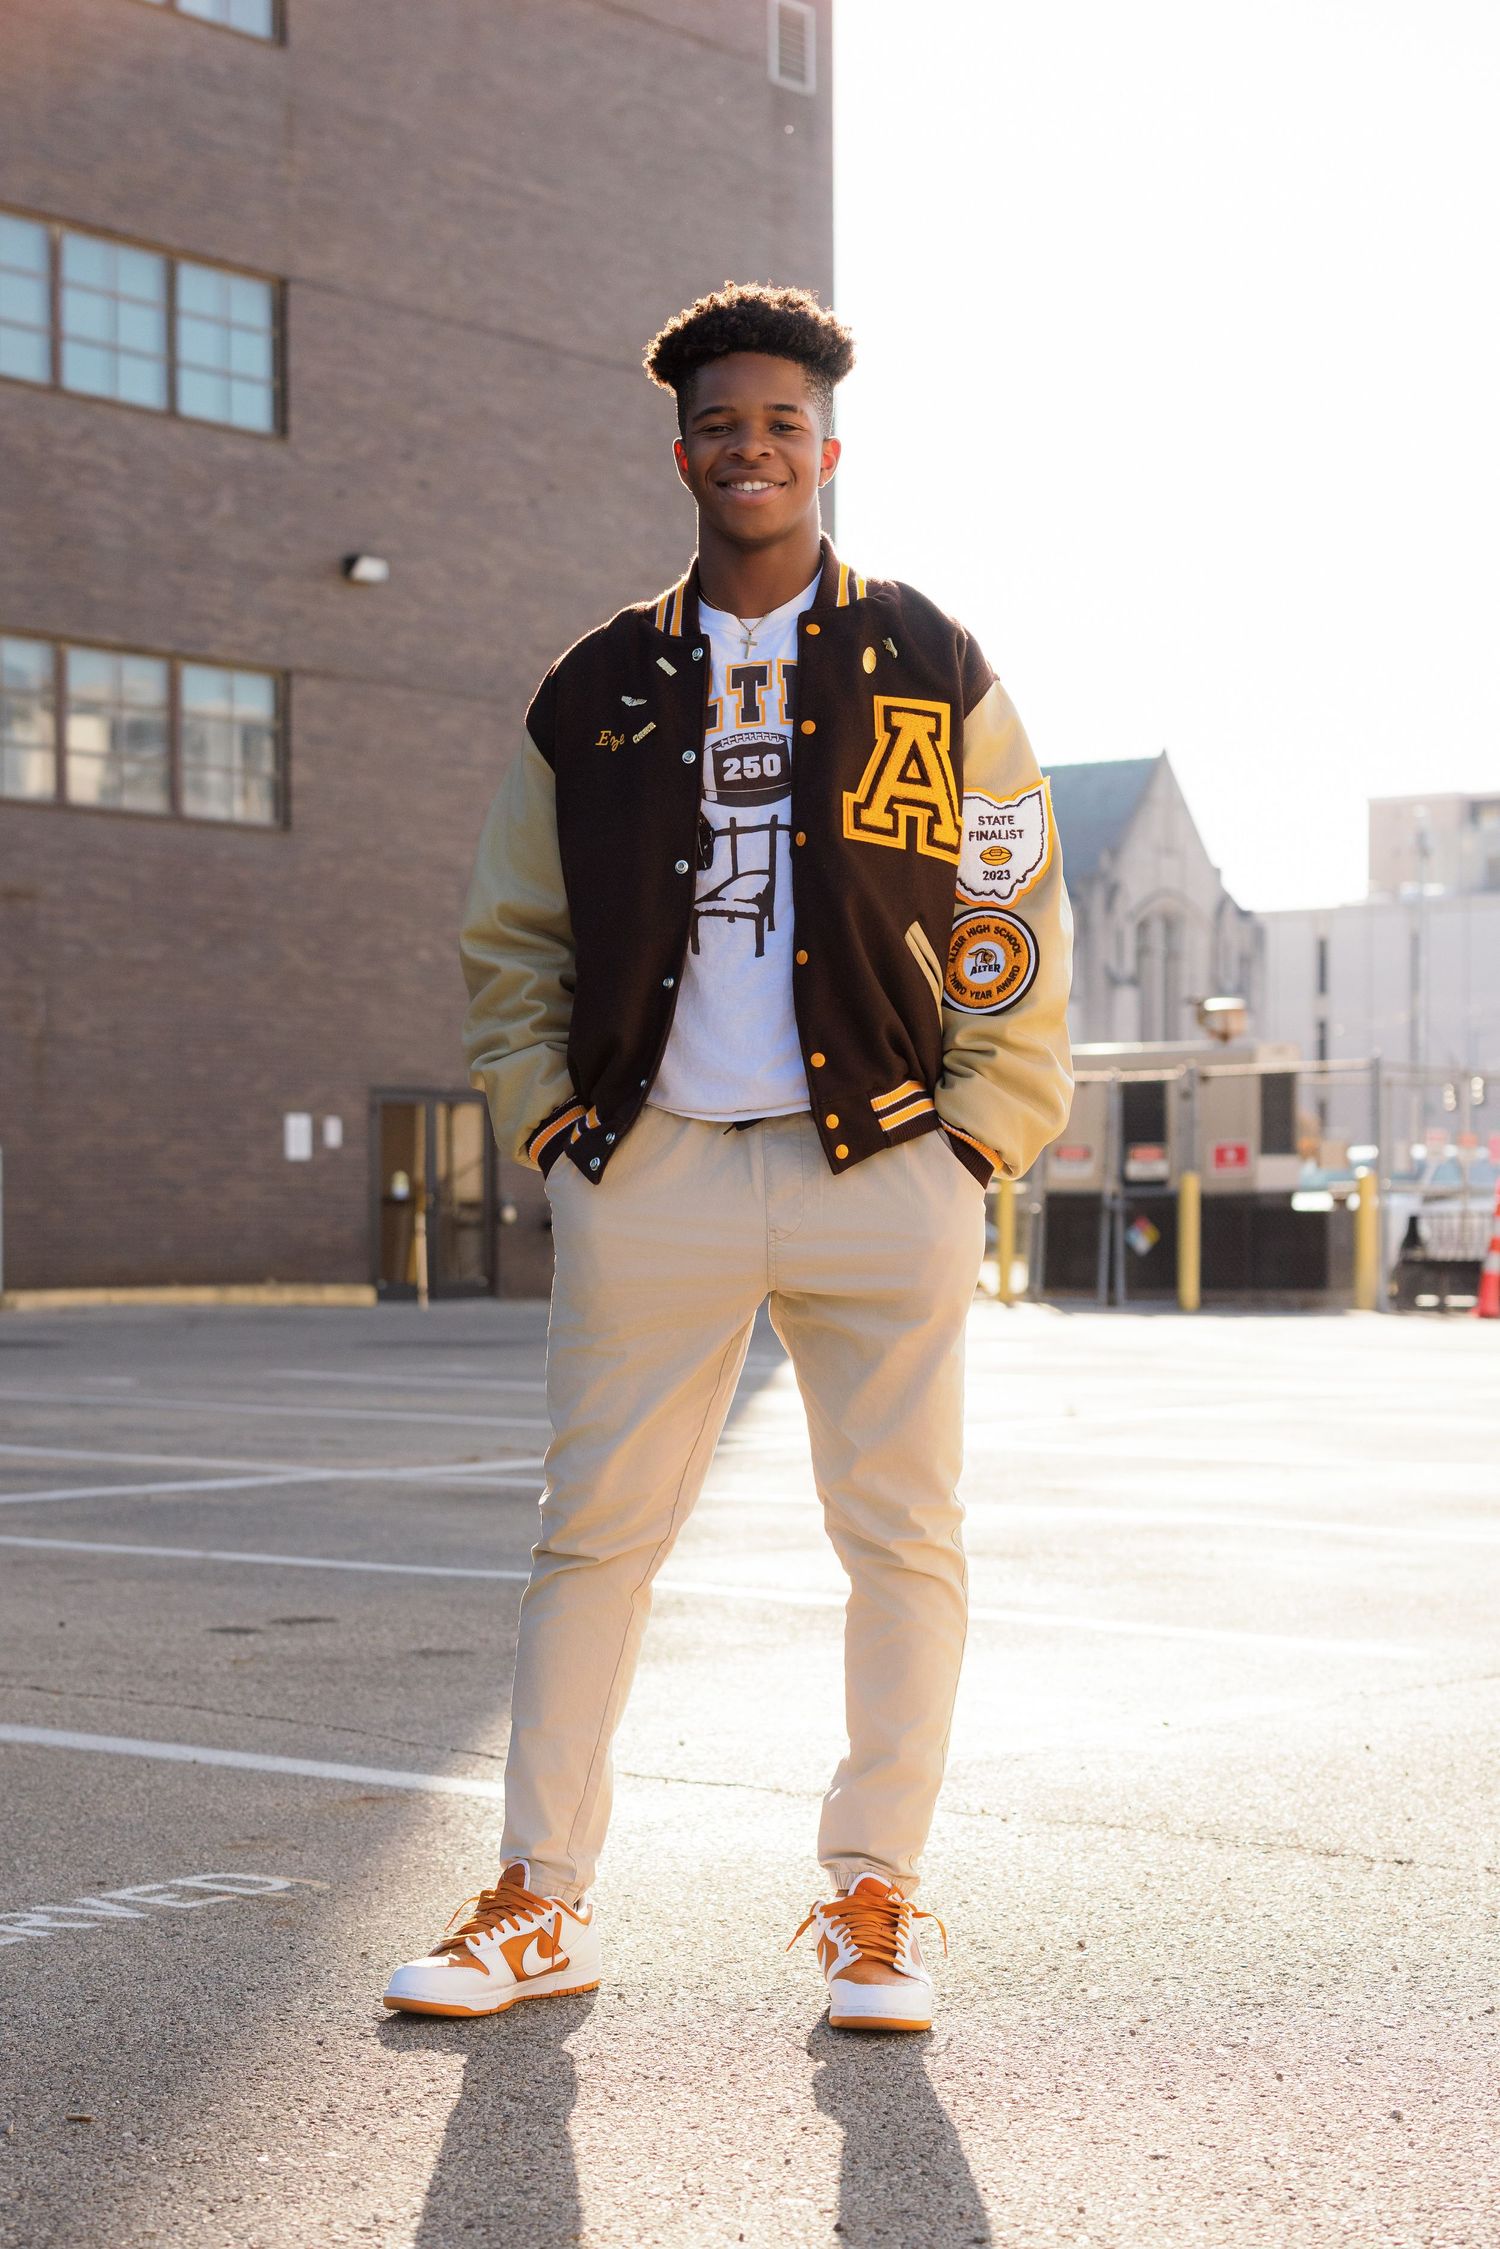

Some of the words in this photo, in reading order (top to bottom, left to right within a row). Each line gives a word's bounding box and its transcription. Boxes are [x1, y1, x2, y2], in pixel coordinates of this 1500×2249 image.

[723, 754, 781, 781] 250
[843, 695, 964, 866] A
[978, 815, 1015, 825] STATE
[968, 829, 1025, 842] FINALIST
[982, 870, 1011, 881] 2023
[966, 924, 990, 938] HIGH
[993, 926, 1021, 957] SCHOOL
[949, 972, 967, 995] THIRD
[970, 990, 992, 1000] YEAR
[996, 965, 1020, 995] AWARD
[970, 964, 1001, 976] ALTER
[0, 1873, 294, 1946] RVED
